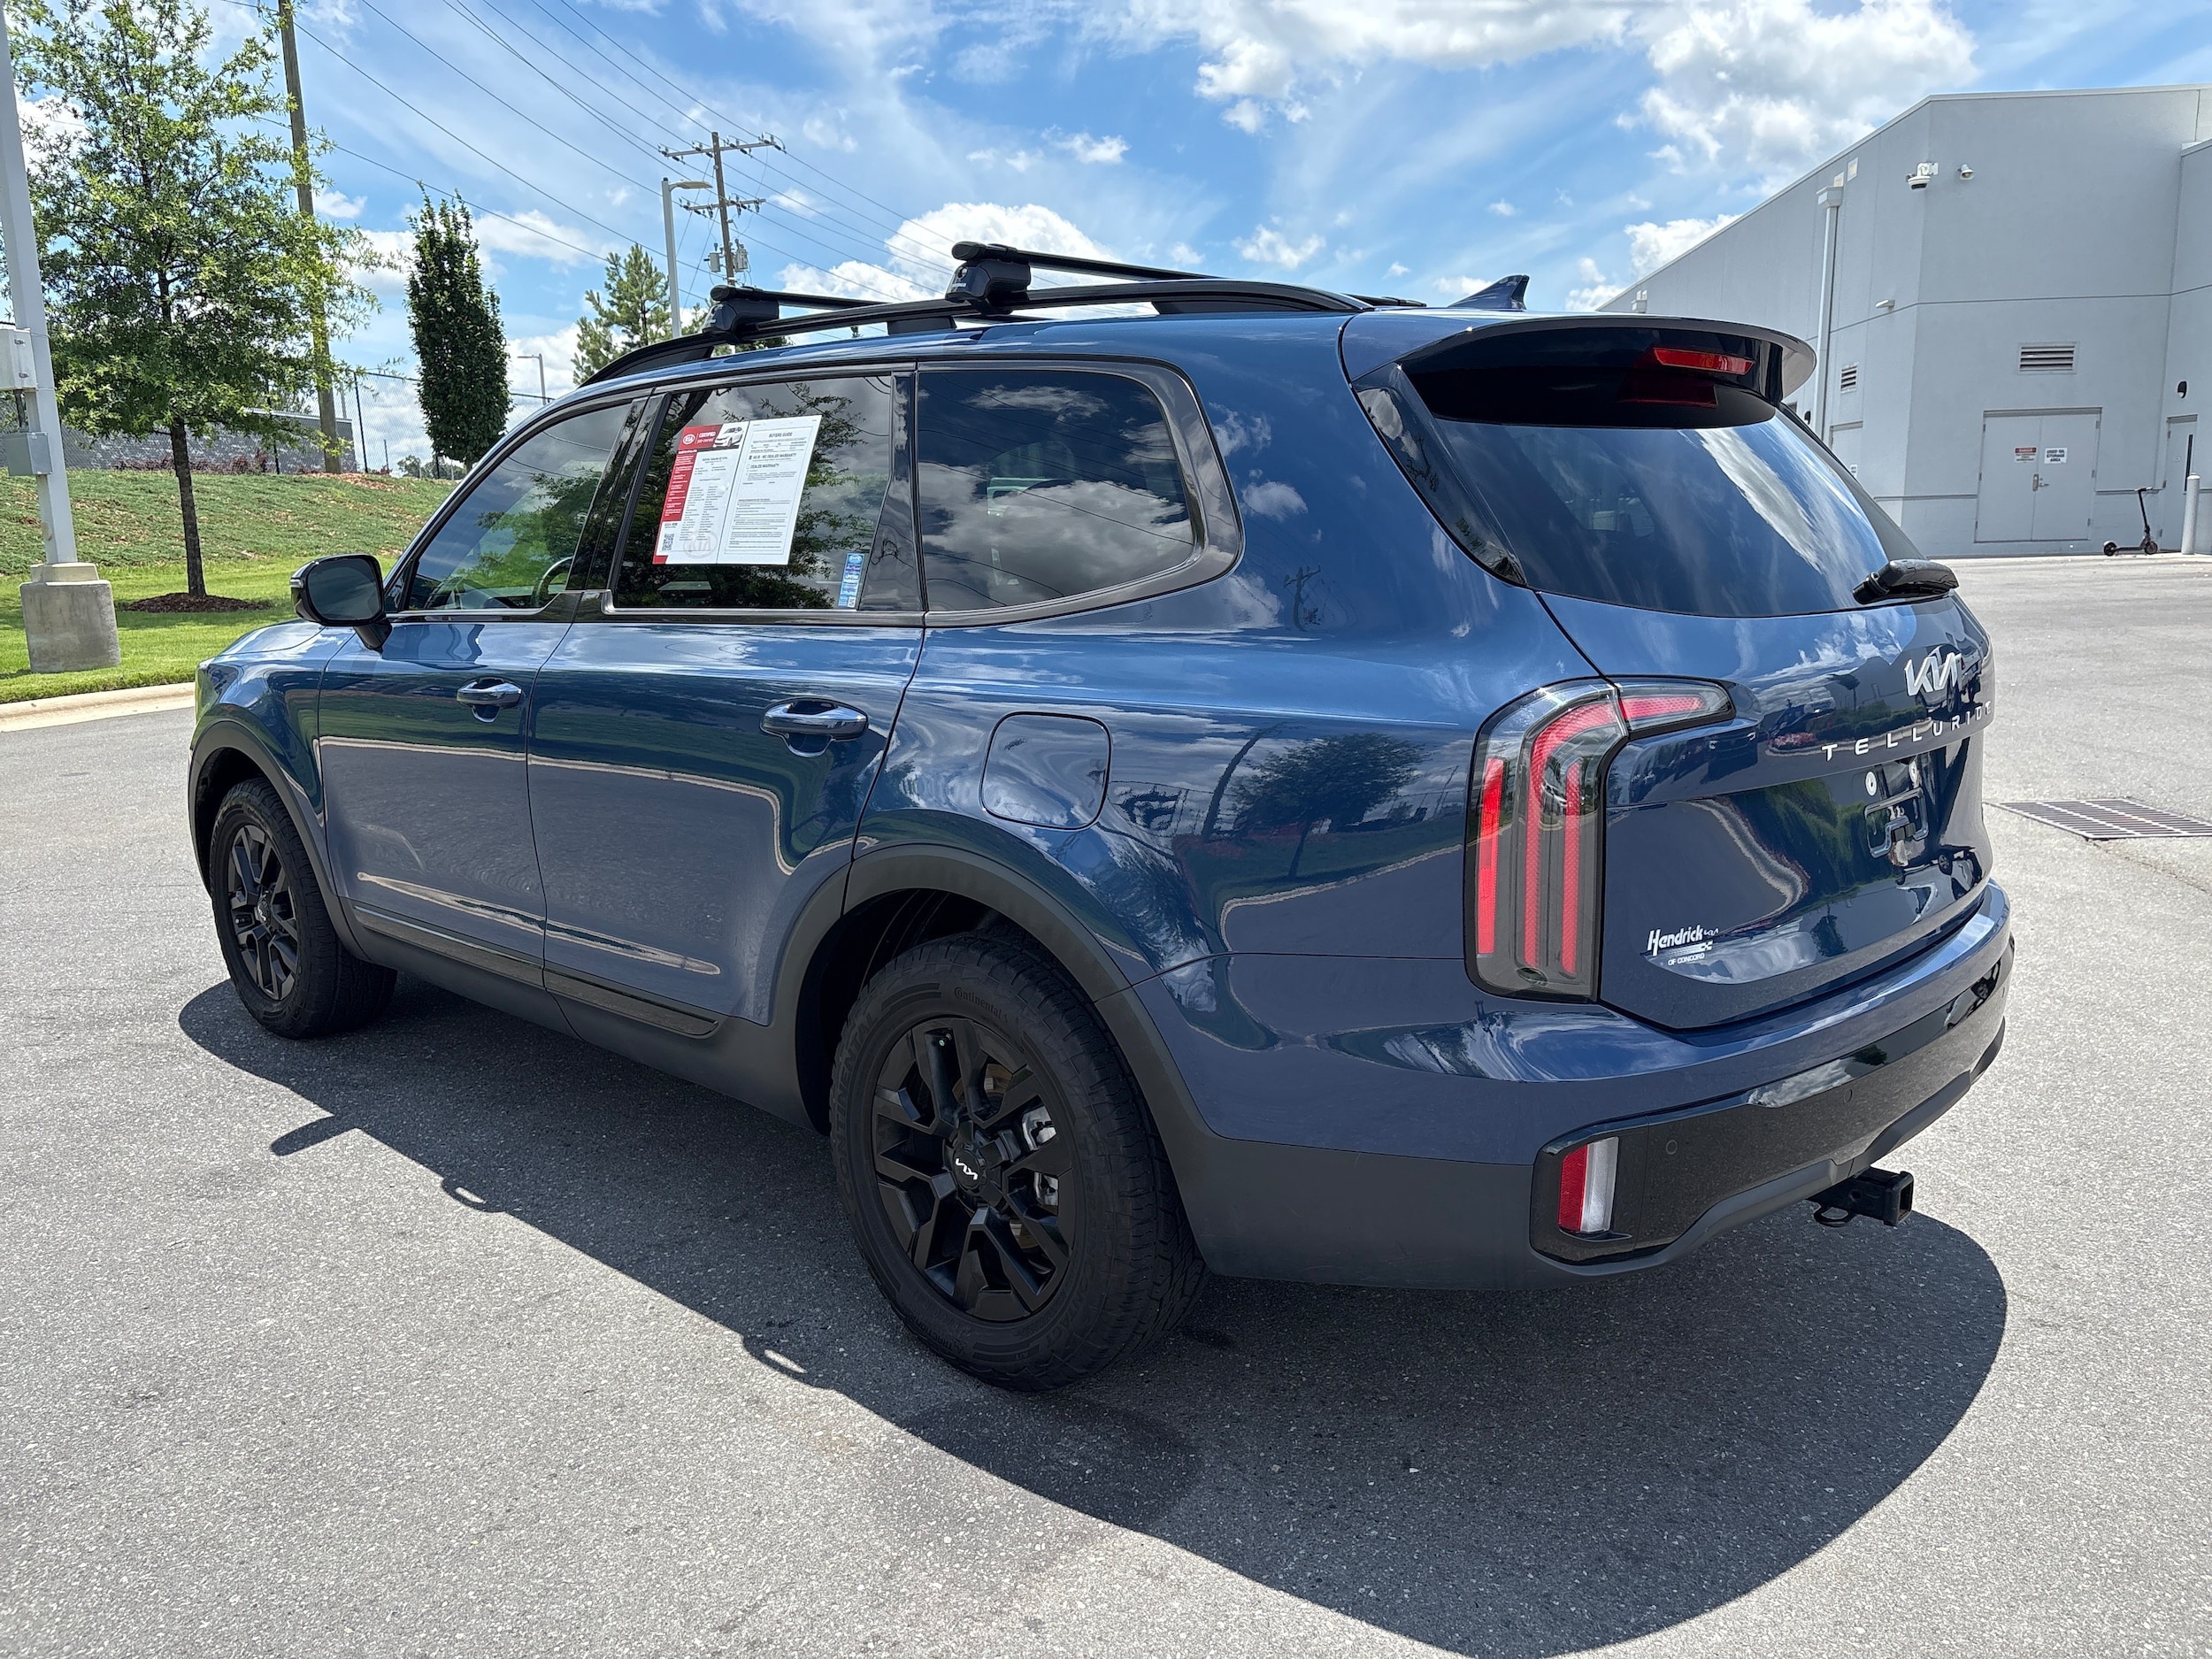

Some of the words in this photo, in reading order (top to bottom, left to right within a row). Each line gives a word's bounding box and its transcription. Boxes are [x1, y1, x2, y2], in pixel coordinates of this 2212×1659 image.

[1821, 700, 1993, 762] TELLURIDE
[1647, 925, 1704, 956] Hendrick
[1677, 953, 1705, 964] CONCORD
[954, 987, 1002, 1020] Continental
[837, 1009, 878, 1201] CONTINENTAL
